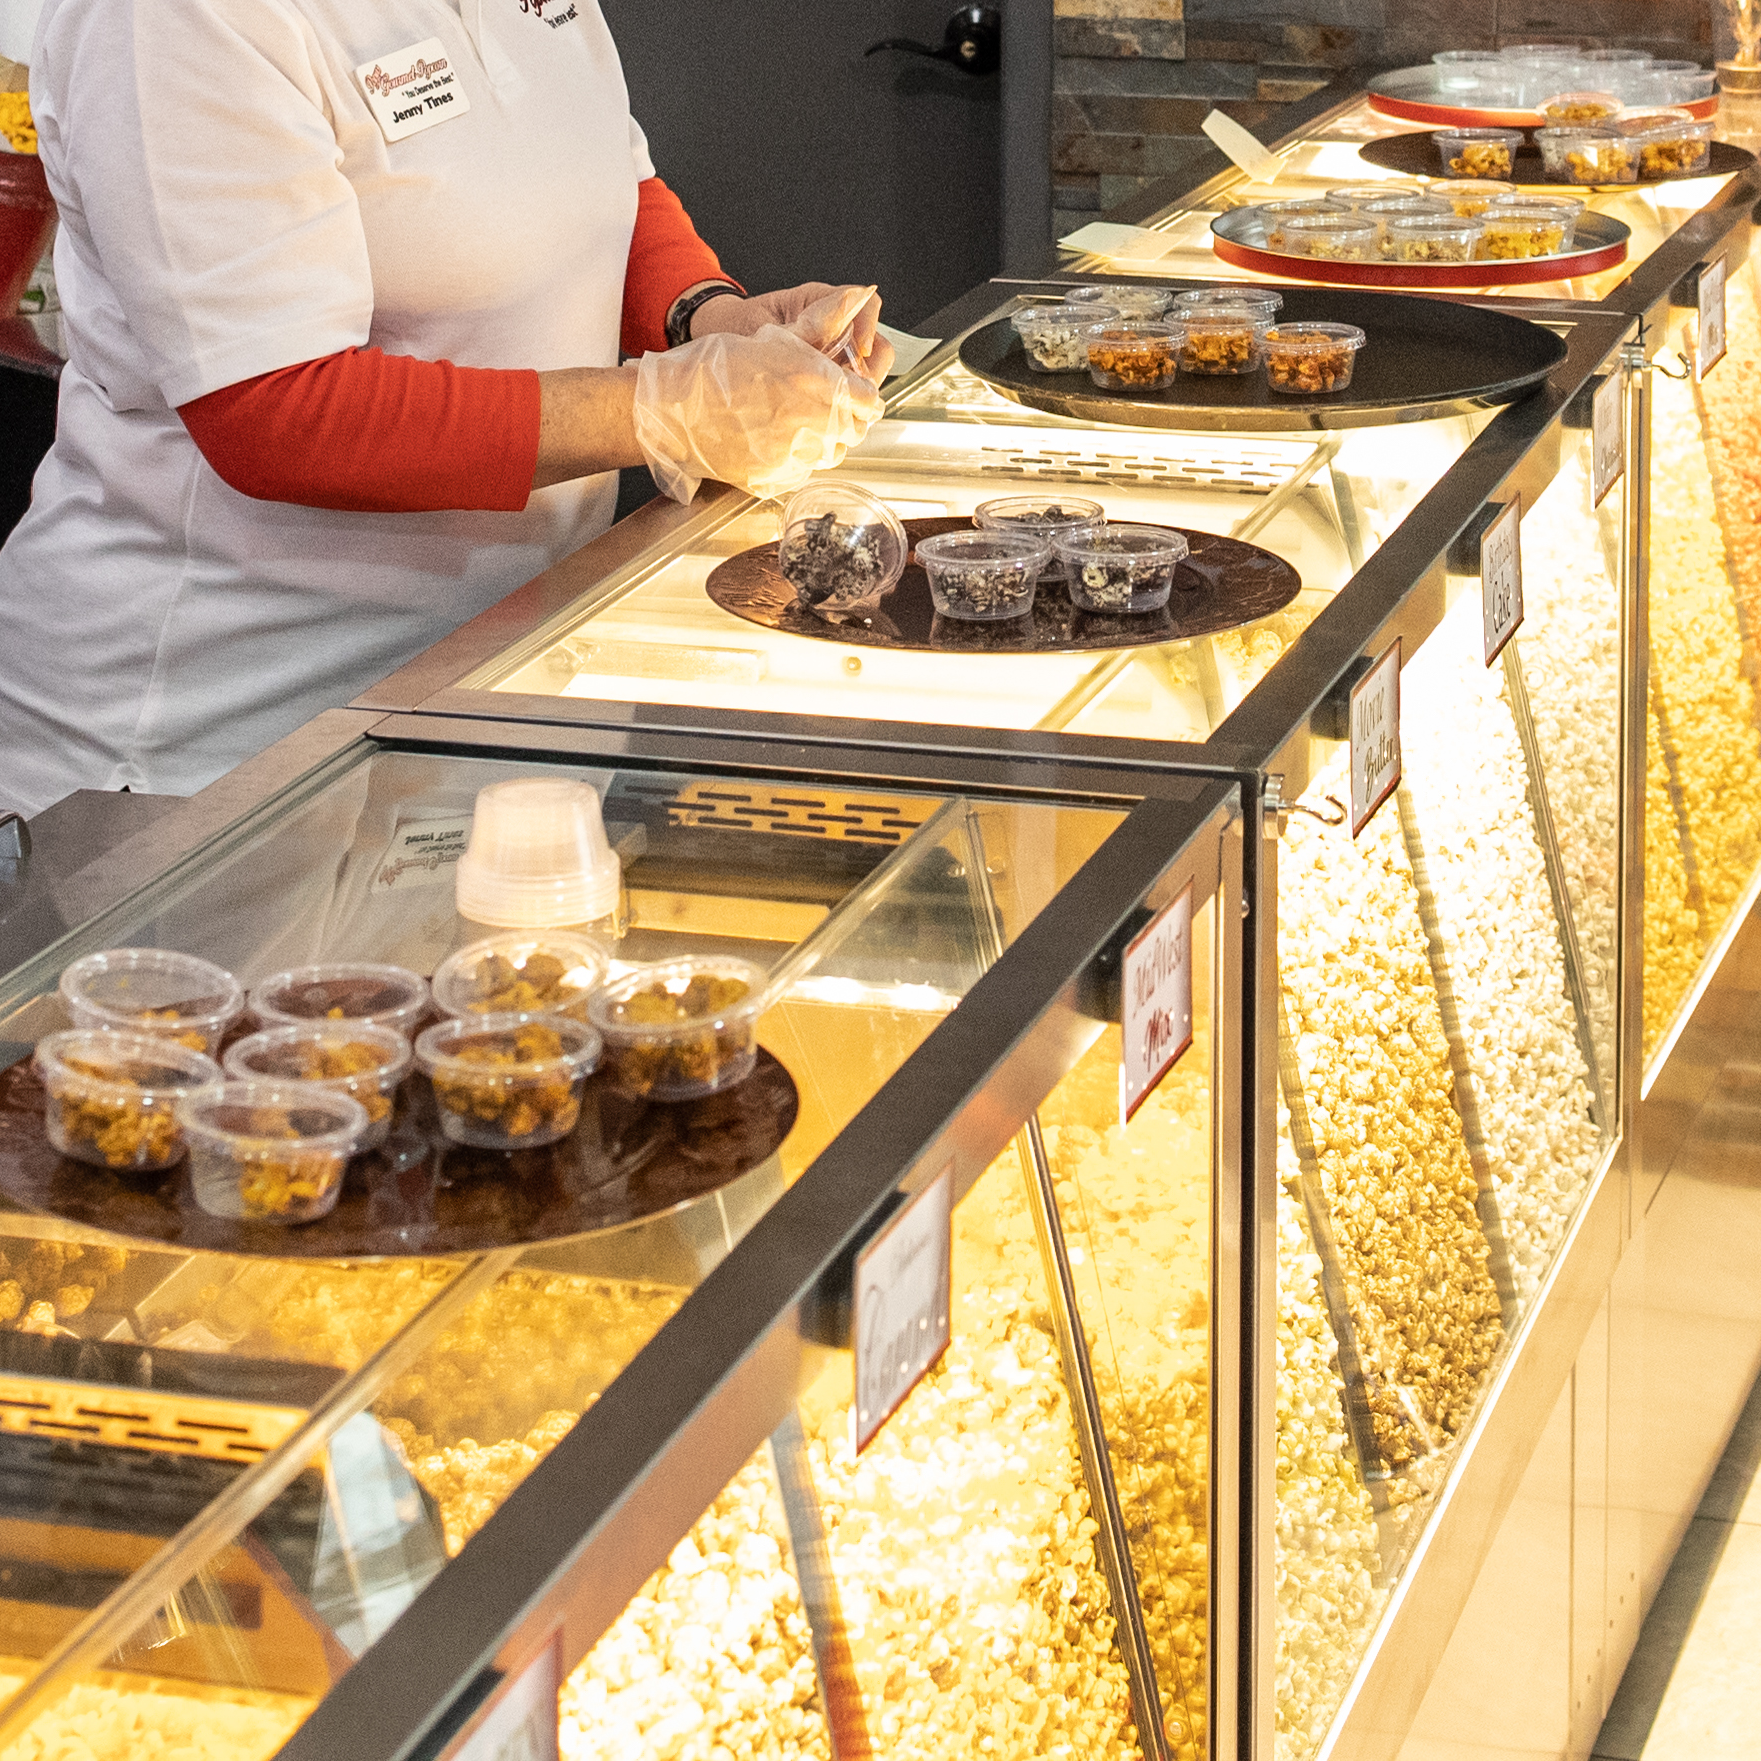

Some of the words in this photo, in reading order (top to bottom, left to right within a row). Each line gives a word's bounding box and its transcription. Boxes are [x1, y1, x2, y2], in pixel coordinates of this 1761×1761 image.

[393, 104, 423, 123] Jenny
[424, 92, 453, 109] Tines
[1364, 730, 1394, 804] Butter
